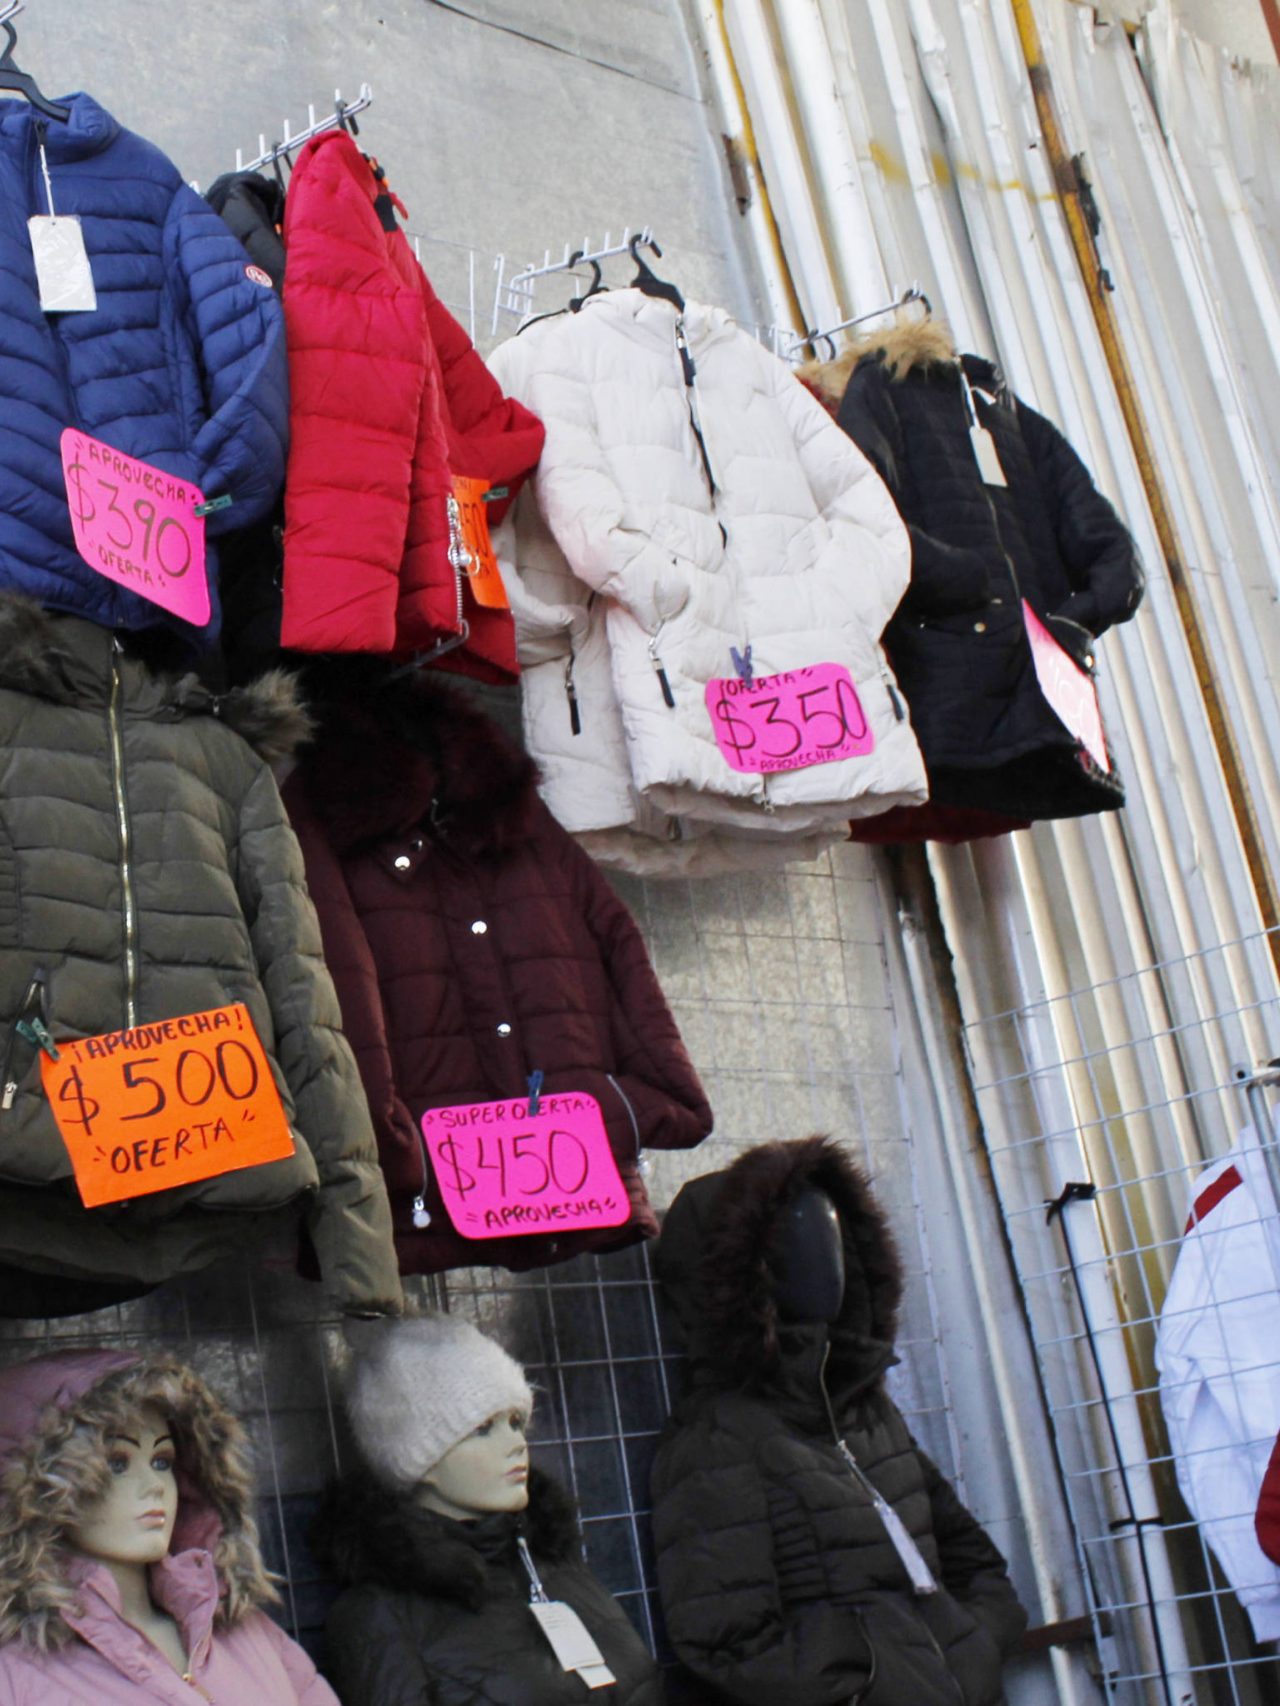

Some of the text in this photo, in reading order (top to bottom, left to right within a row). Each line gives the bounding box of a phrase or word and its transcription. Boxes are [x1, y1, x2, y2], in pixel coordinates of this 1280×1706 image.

[67, 452, 192, 577] $390
[716, 678, 867, 766] $350
[71, 1008, 244, 1062] ¡APROVECHA!
[58, 1039, 258, 1136] $500
[511, 1098, 596, 1120] OERTA"
[437, 1130, 588, 1201] $450
